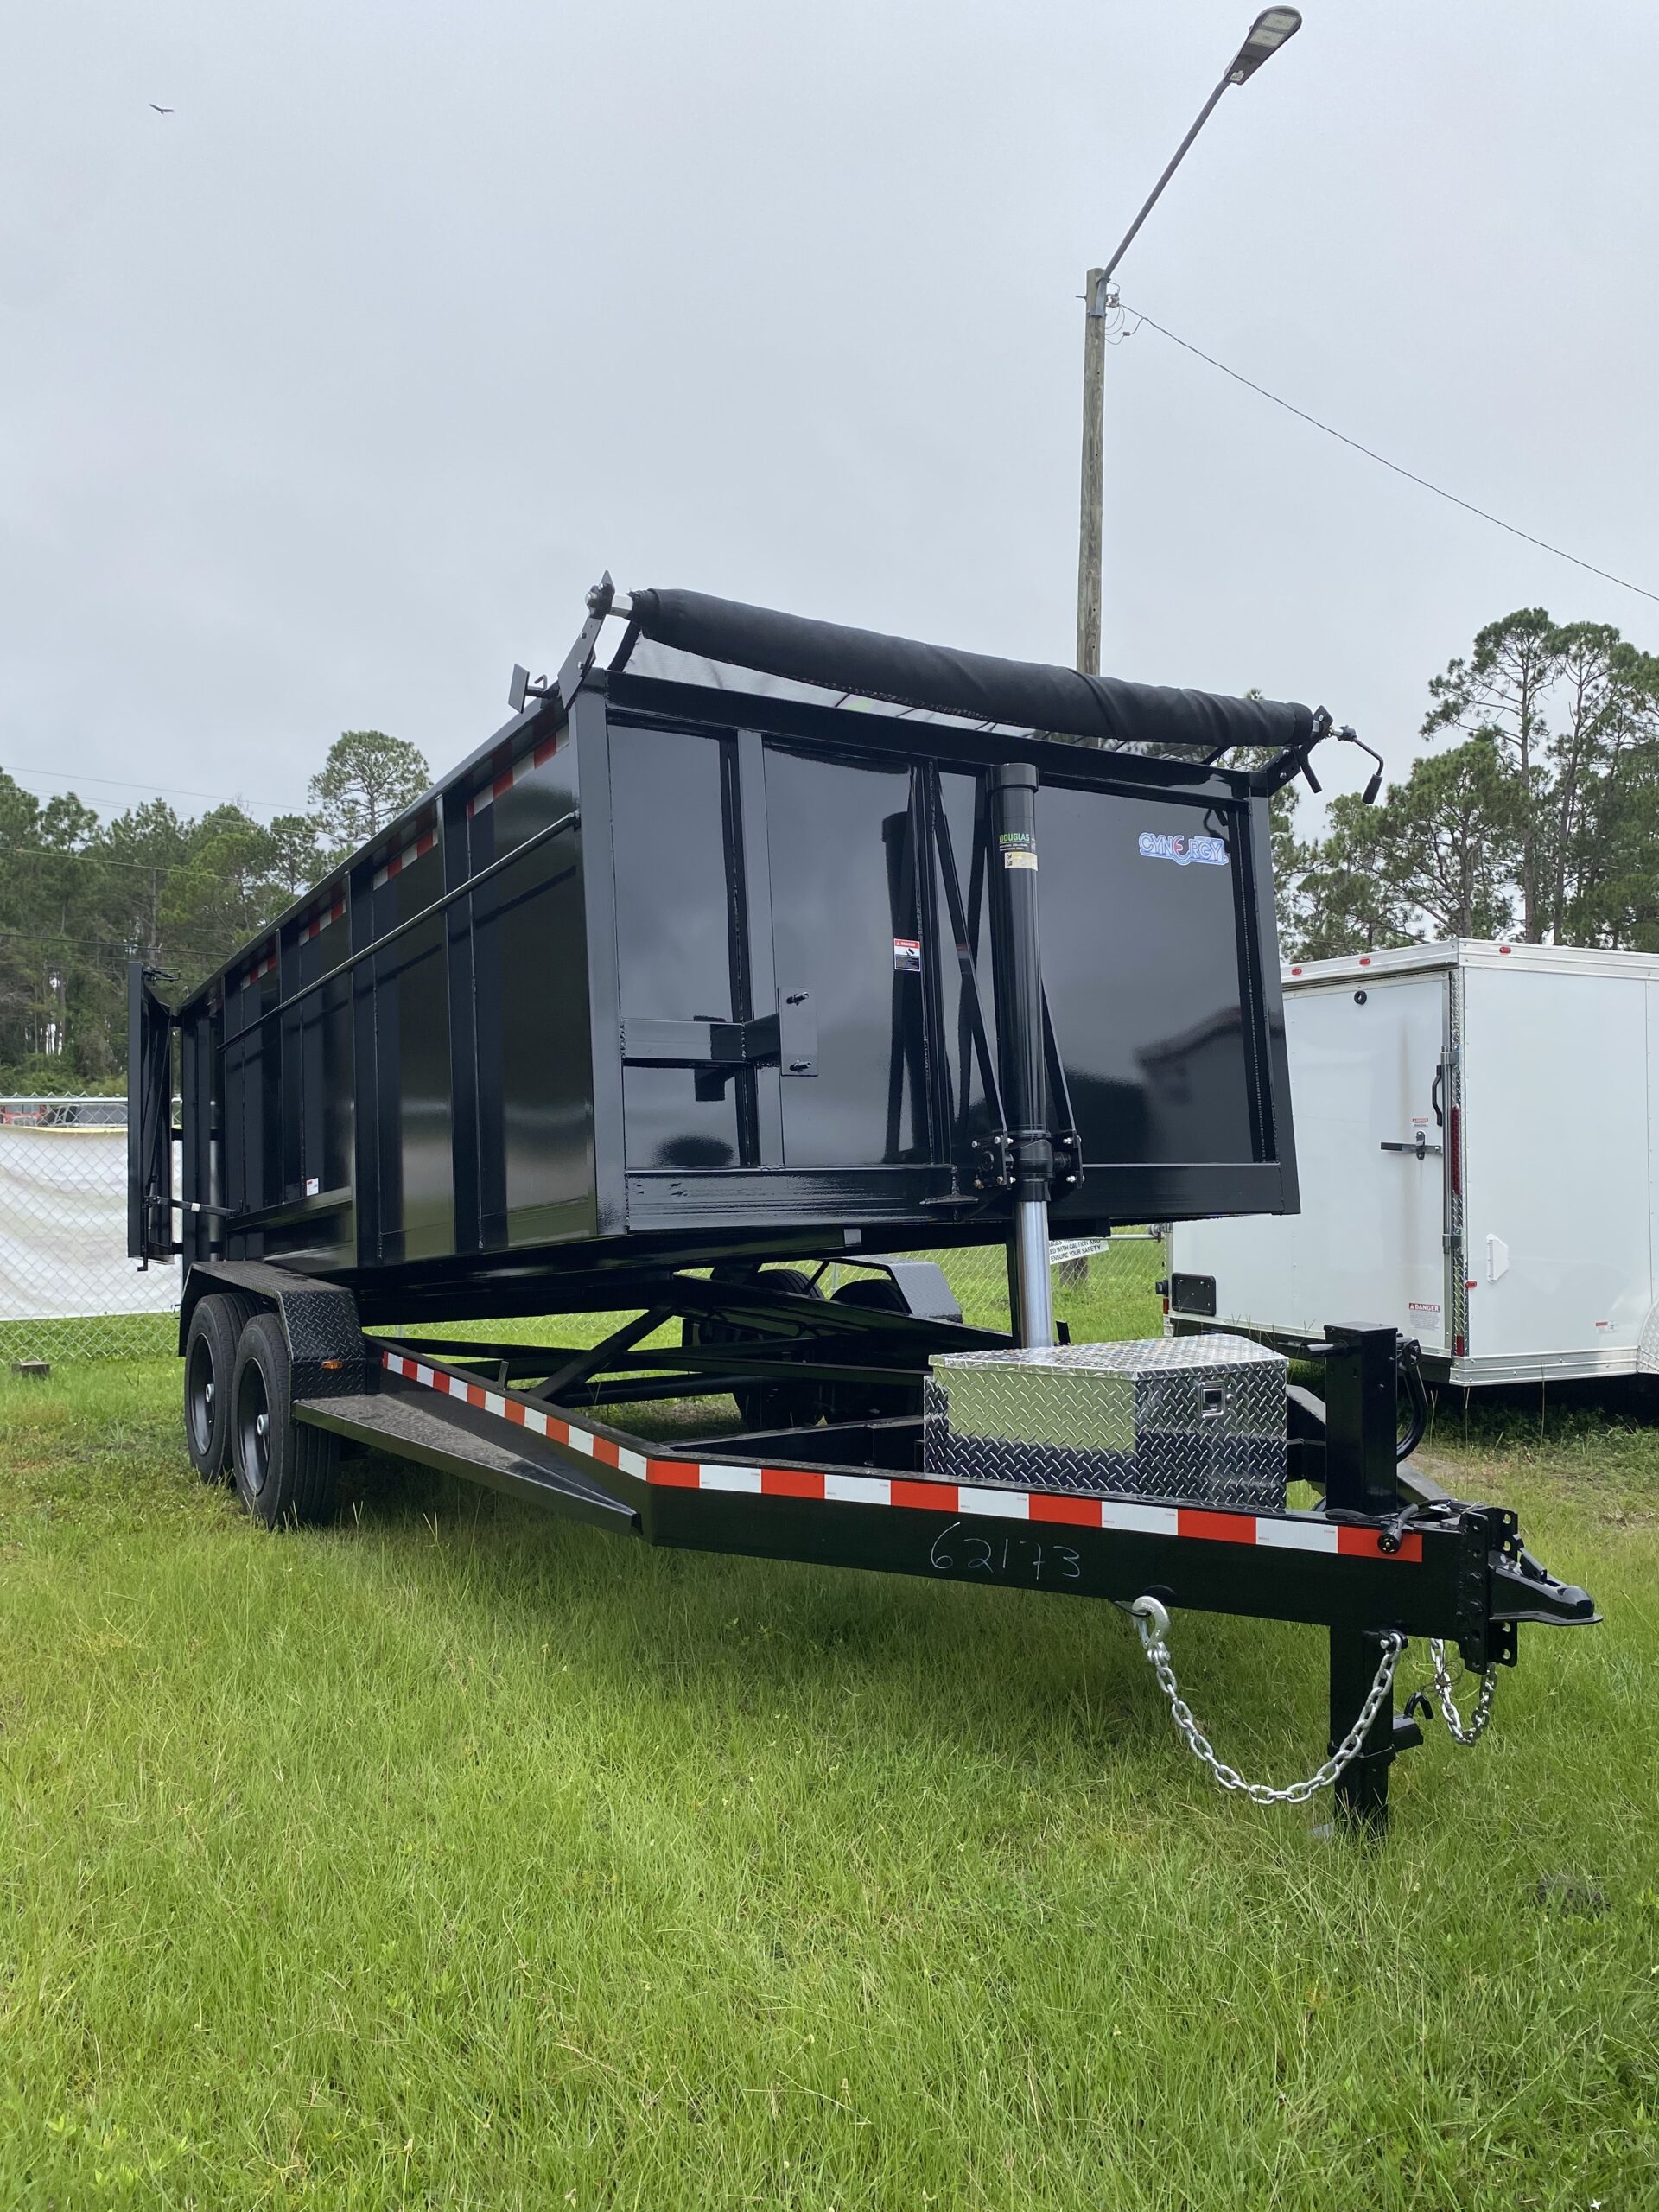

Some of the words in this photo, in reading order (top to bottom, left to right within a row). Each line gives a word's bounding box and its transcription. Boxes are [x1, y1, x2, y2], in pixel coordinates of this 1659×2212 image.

[999, 833, 1030, 843] DOUGLAS
[1139, 832, 1224, 861] CYNERGY
[1069, 1241, 1089, 1249] CAUTION
[1050, 1252, 1069, 1262] ENSURE
[931, 1522, 1080, 1580] 62173
